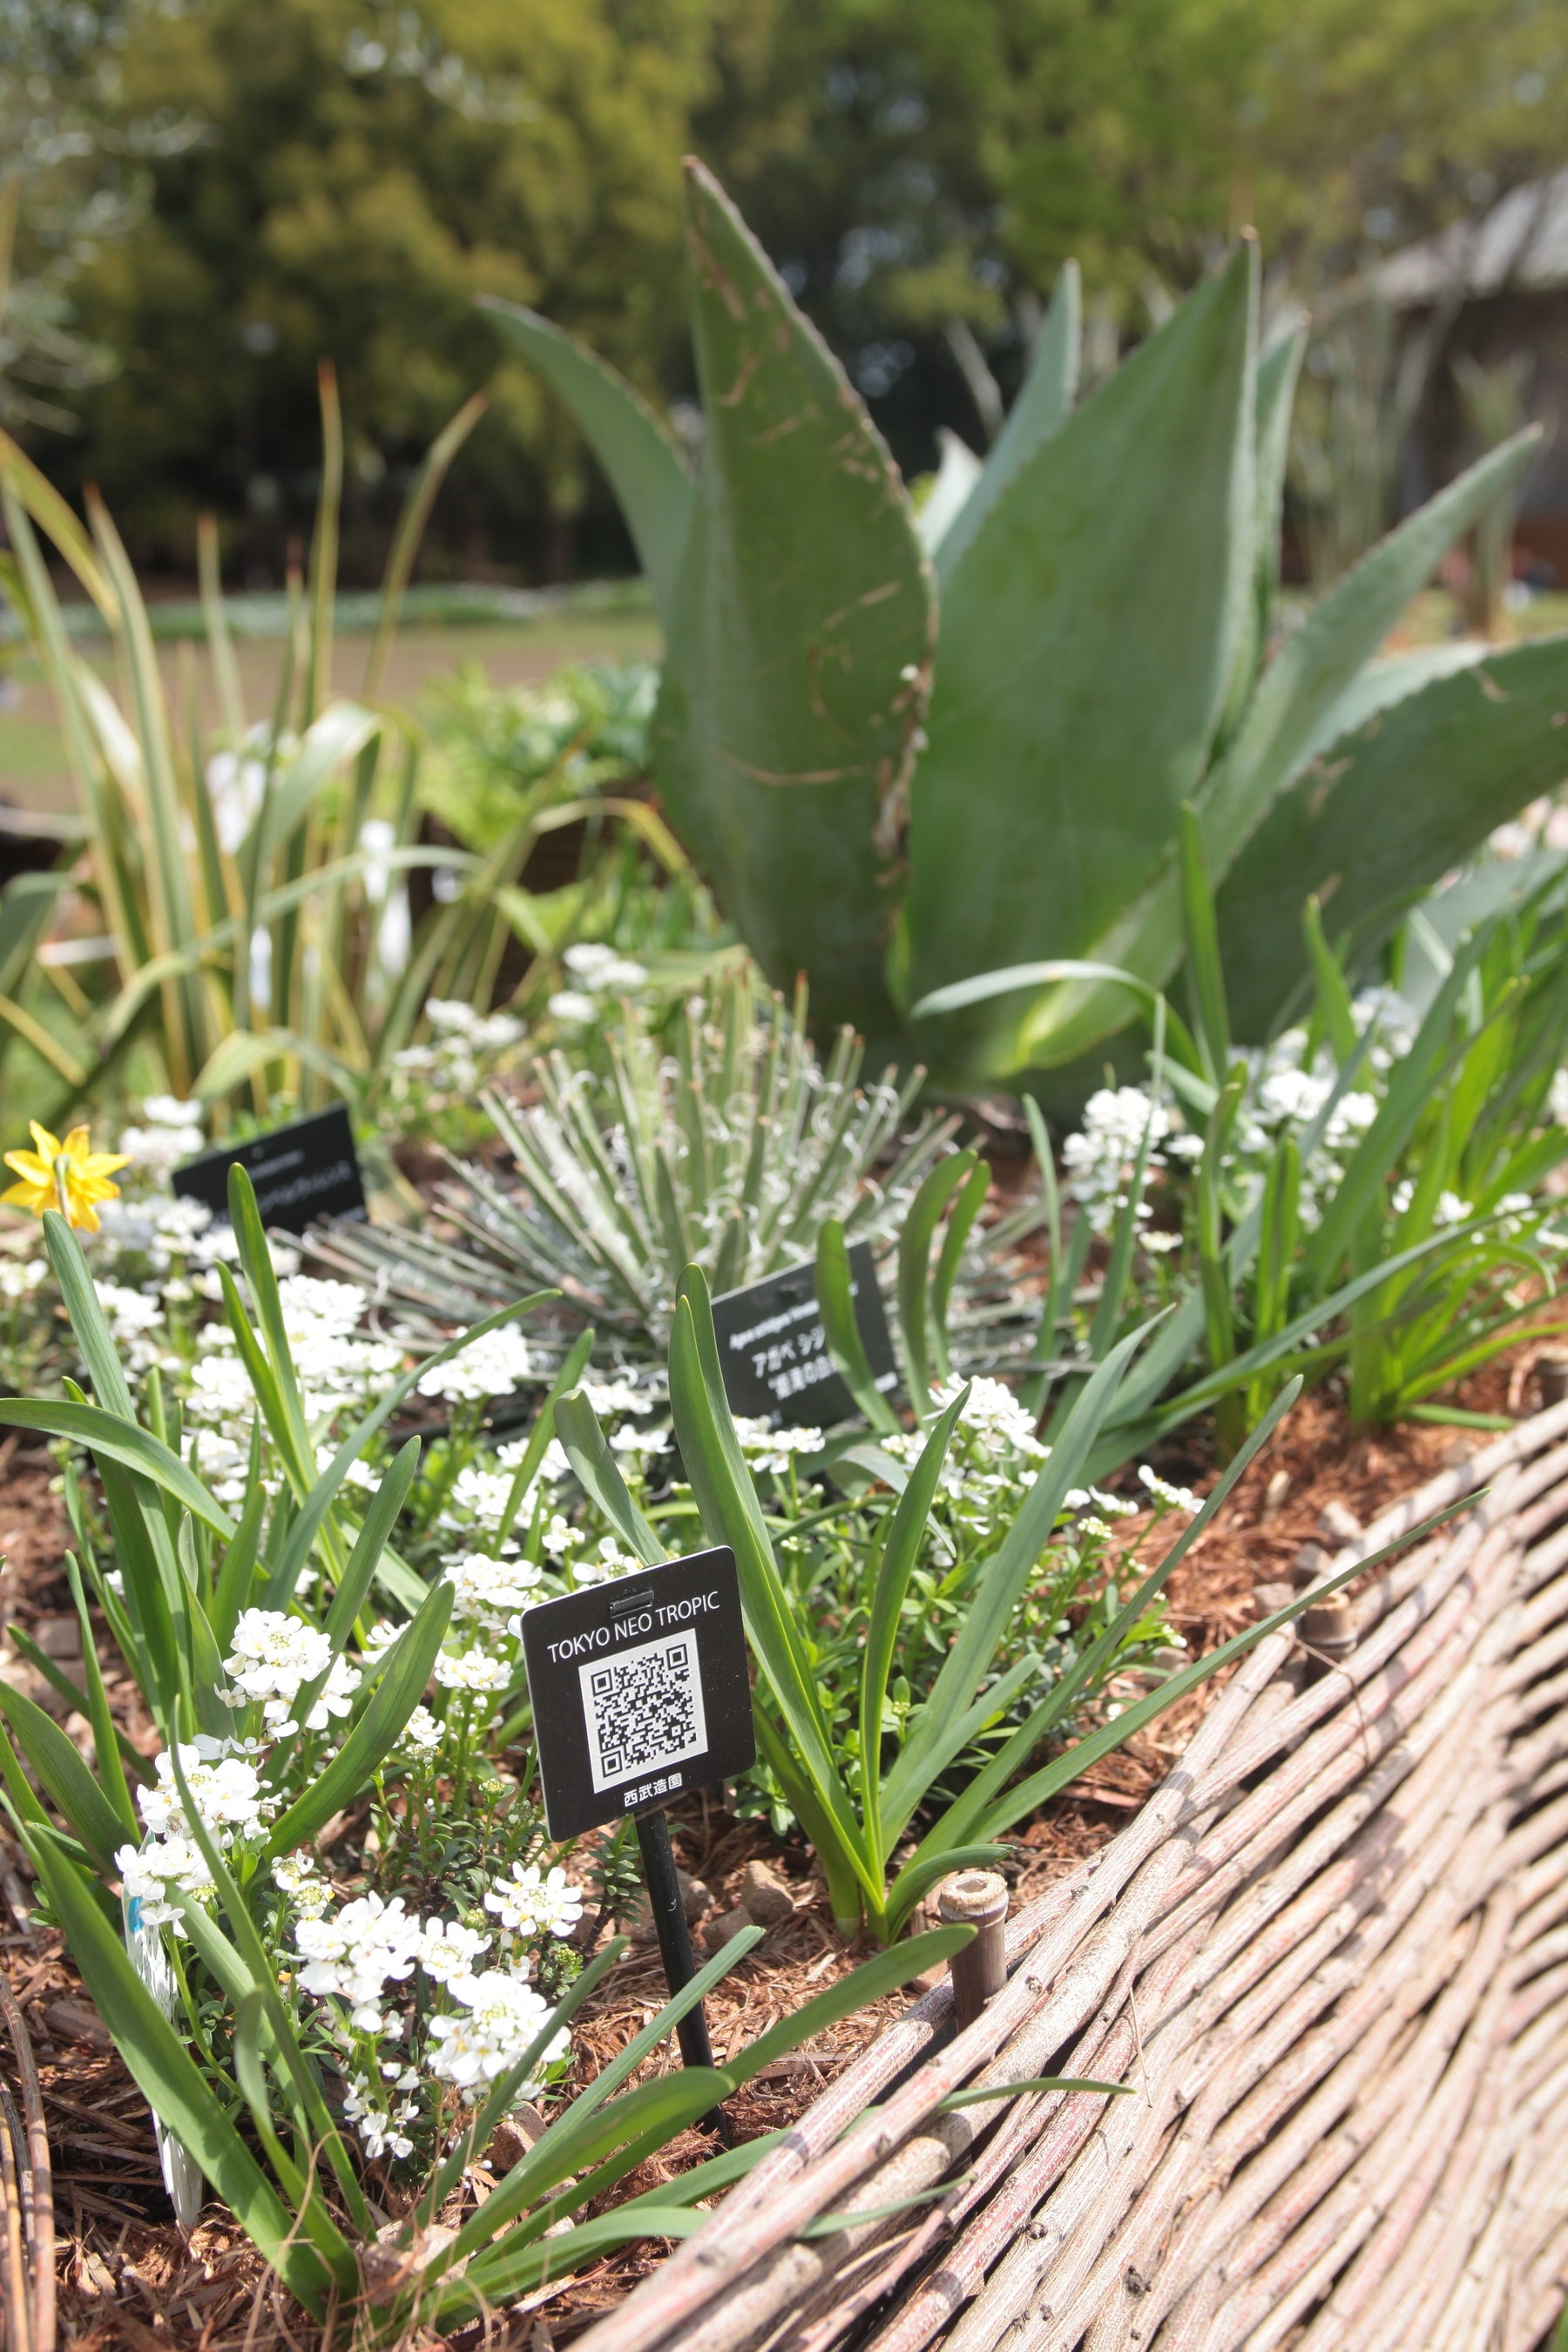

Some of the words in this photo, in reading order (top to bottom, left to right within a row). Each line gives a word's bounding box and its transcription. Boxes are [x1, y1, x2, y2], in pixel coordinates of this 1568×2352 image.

[547, 1627, 610, 1663] TOKYO
[614, 1613, 652, 1641] NEO
[655, 1591, 720, 1626] TROPIC
[624, 1772, 682, 1808] 西武造園
